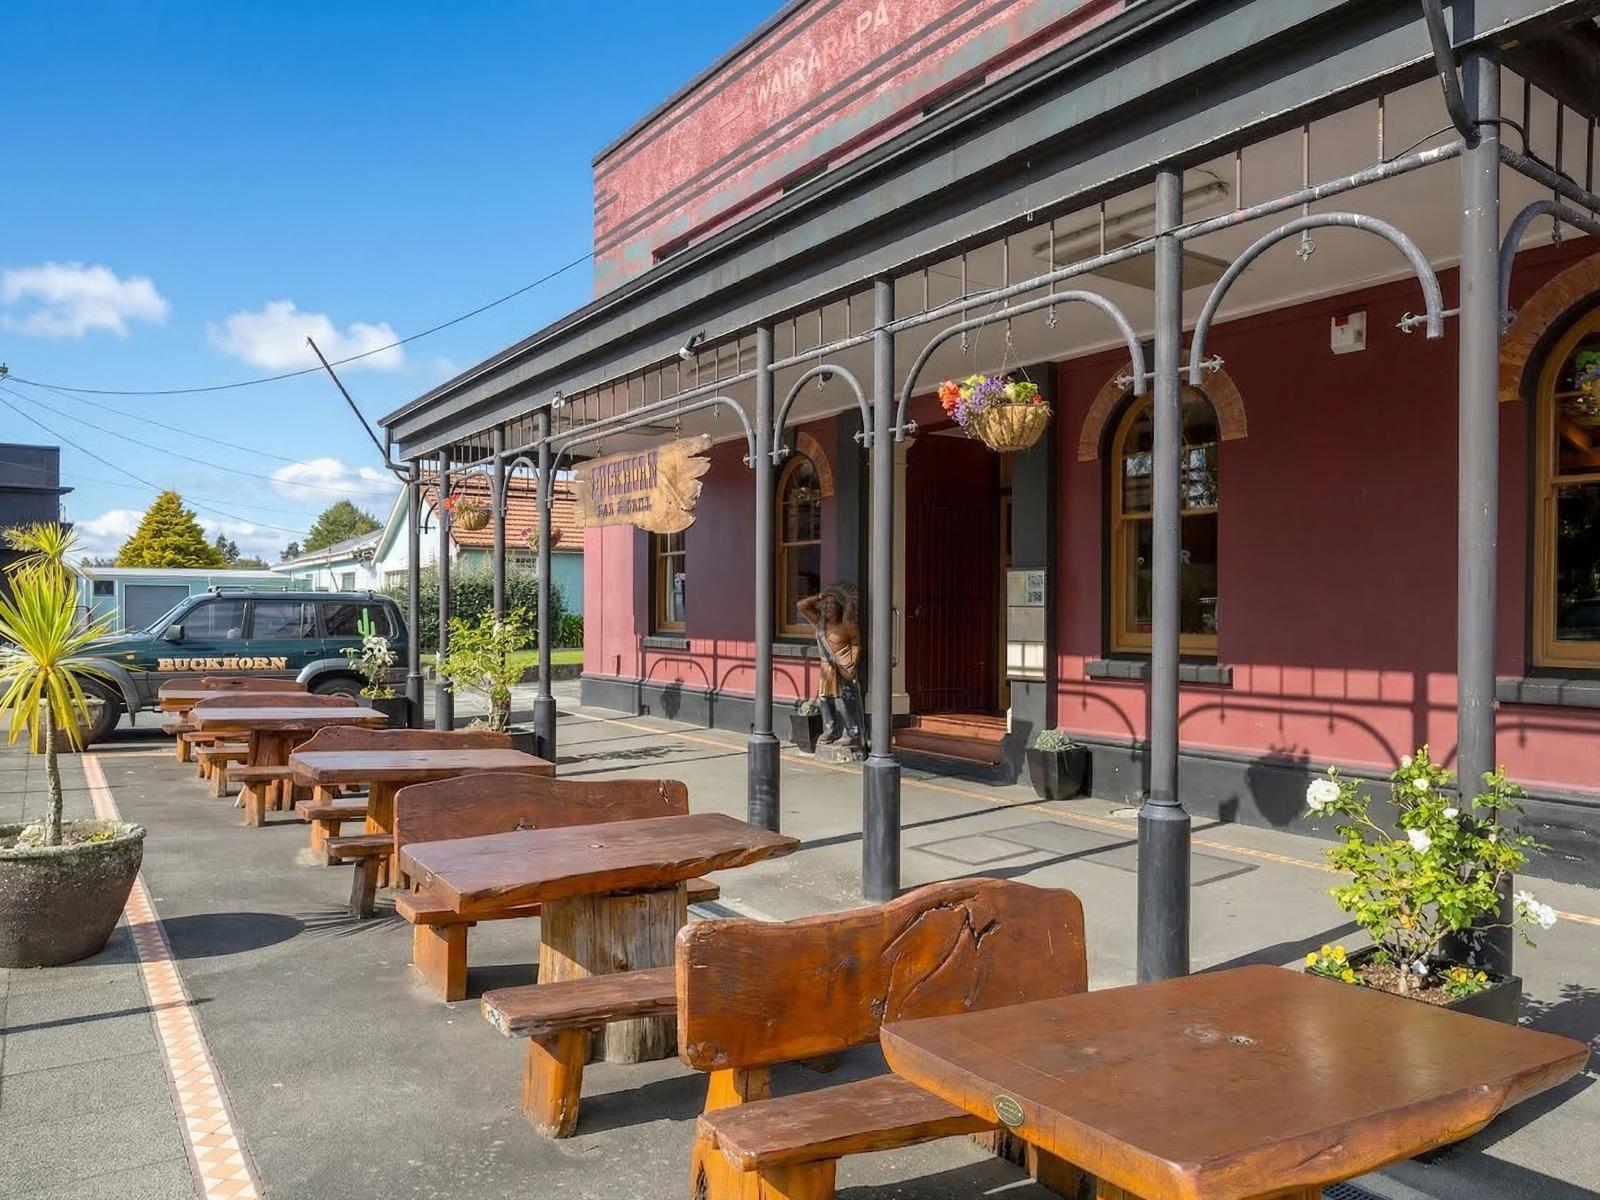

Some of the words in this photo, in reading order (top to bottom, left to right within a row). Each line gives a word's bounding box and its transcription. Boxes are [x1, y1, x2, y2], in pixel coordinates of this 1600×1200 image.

[757, 0, 889, 108] WAIRARAPA
[592, 451, 657, 500] BUCKHORN
[158, 656, 287, 671] BUCKHORN
